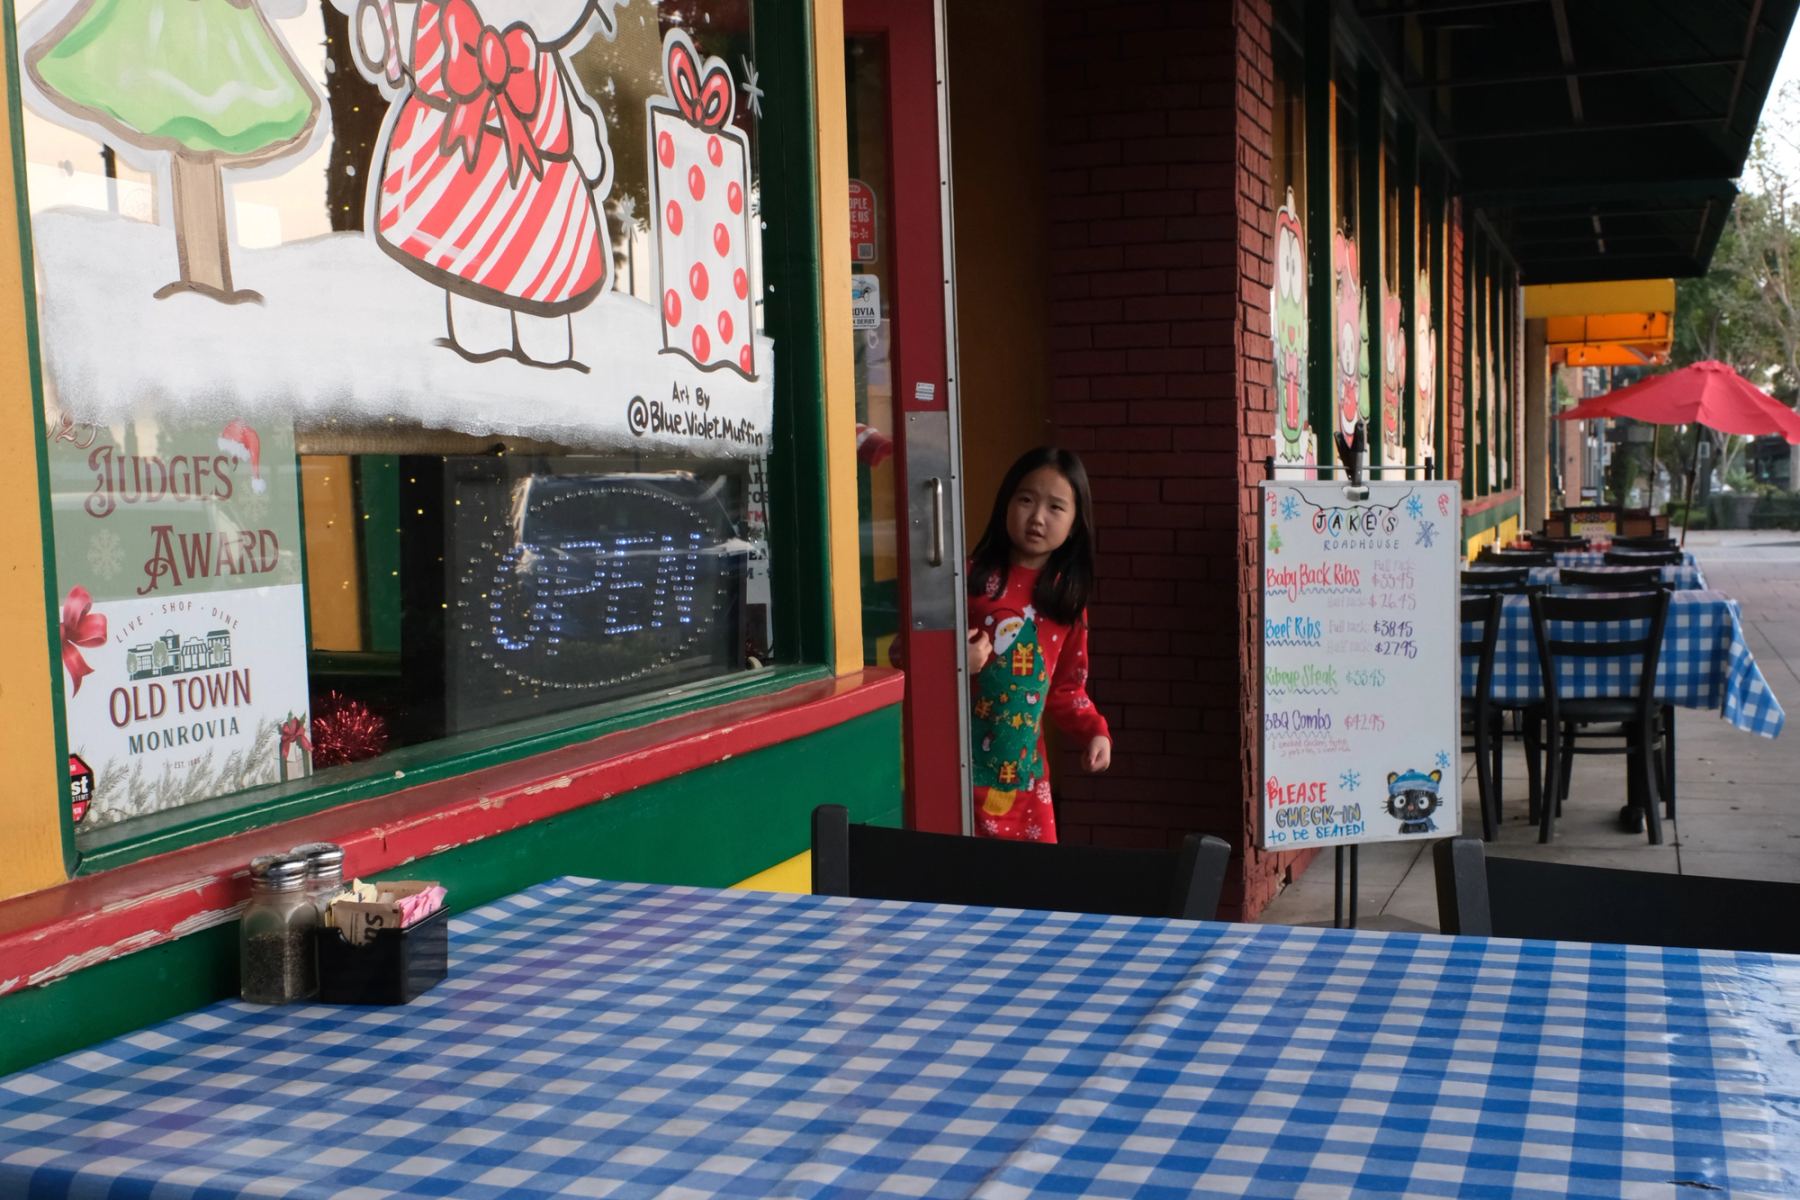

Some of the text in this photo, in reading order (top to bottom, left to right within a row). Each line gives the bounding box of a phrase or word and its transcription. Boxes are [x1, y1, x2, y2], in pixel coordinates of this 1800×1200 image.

[672, 380, 710, 412] Art By
[1316, 509, 1396, 532] JAKE'S
[137, 525, 279, 595] AWARD
[1323, 539, 1399, 551] ROADHOUSE
[490, 532, 702, 656] OPEN
[1266, 562, 1360, 603] Baby Back Ribs
[116, 615, 143, 643] LIVE
[211, 607, 239, 630] DINE
[1265, 616, 1291, 639] Beef
[1295, 616, 1321, 640] Ribs
[109, 668, 251, 729] OLD TOWN
[128, 716, 240, 755] MONROVIA
[1264, 710, 1289, 731] BBQ
[1292, 708, 1331, 731] Combo
[1267, 777, 1328, 809] PLEASE
[1276, 803, 1361, 828] CHECK-IN
[1269, 820, 1365, 844] to be SEATED!
